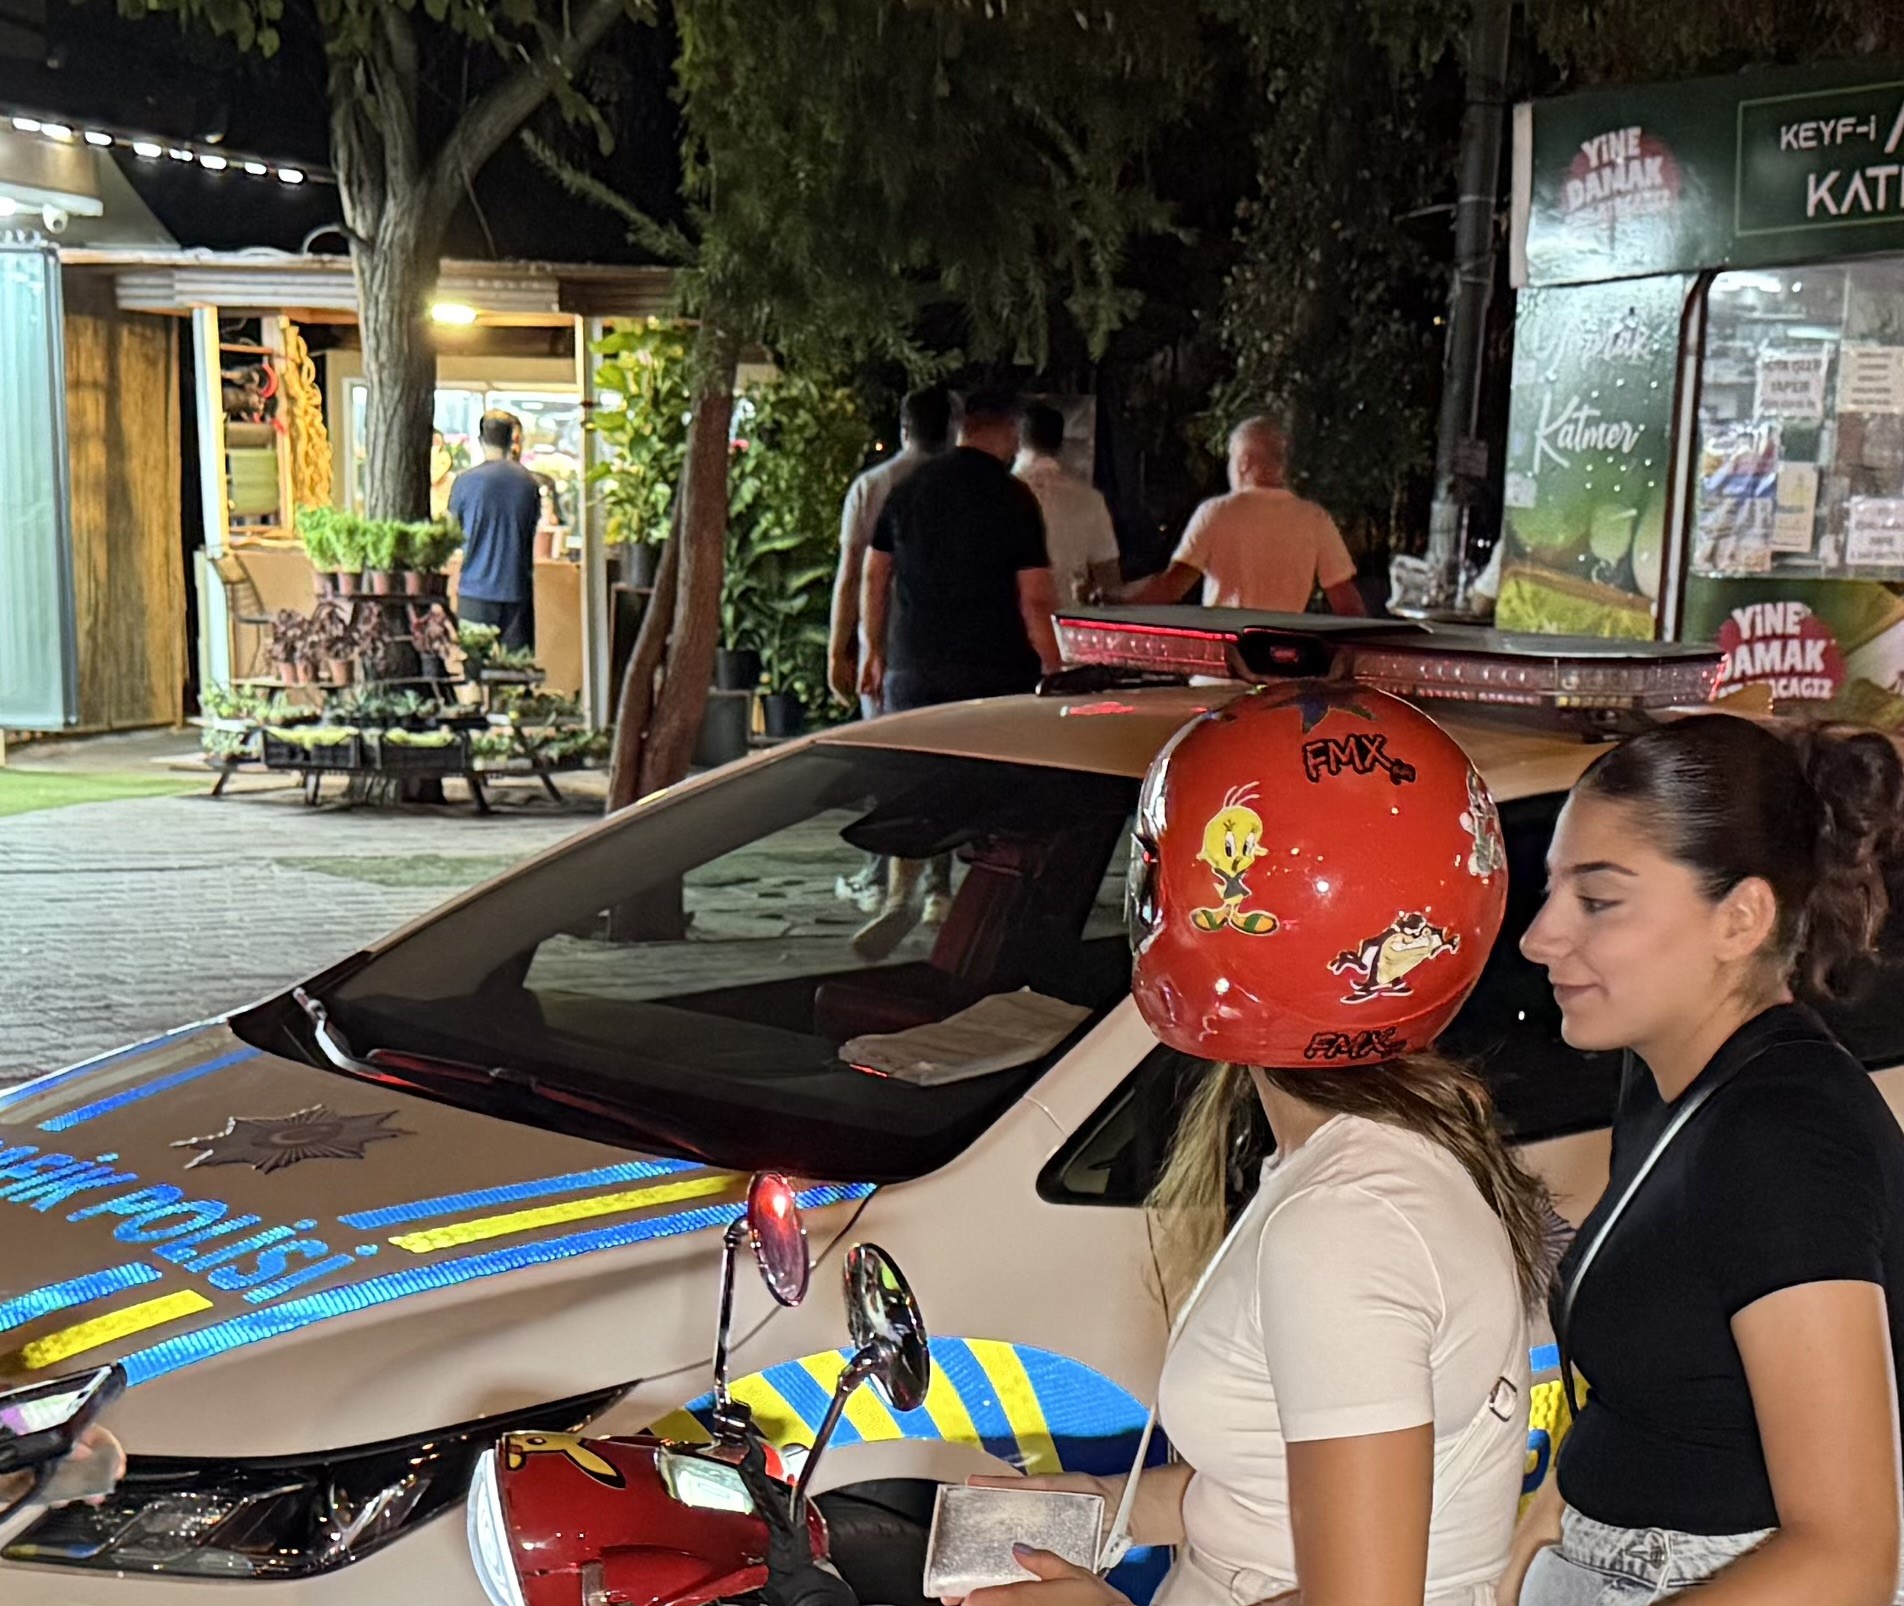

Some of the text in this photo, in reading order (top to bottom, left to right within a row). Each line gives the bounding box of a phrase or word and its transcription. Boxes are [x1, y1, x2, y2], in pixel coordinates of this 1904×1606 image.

[1533, 391, 1644, 475] Katmer
[1302, 733, 1393, 783] FMX
[66, 1183, 379, 1304] POLİSİ
